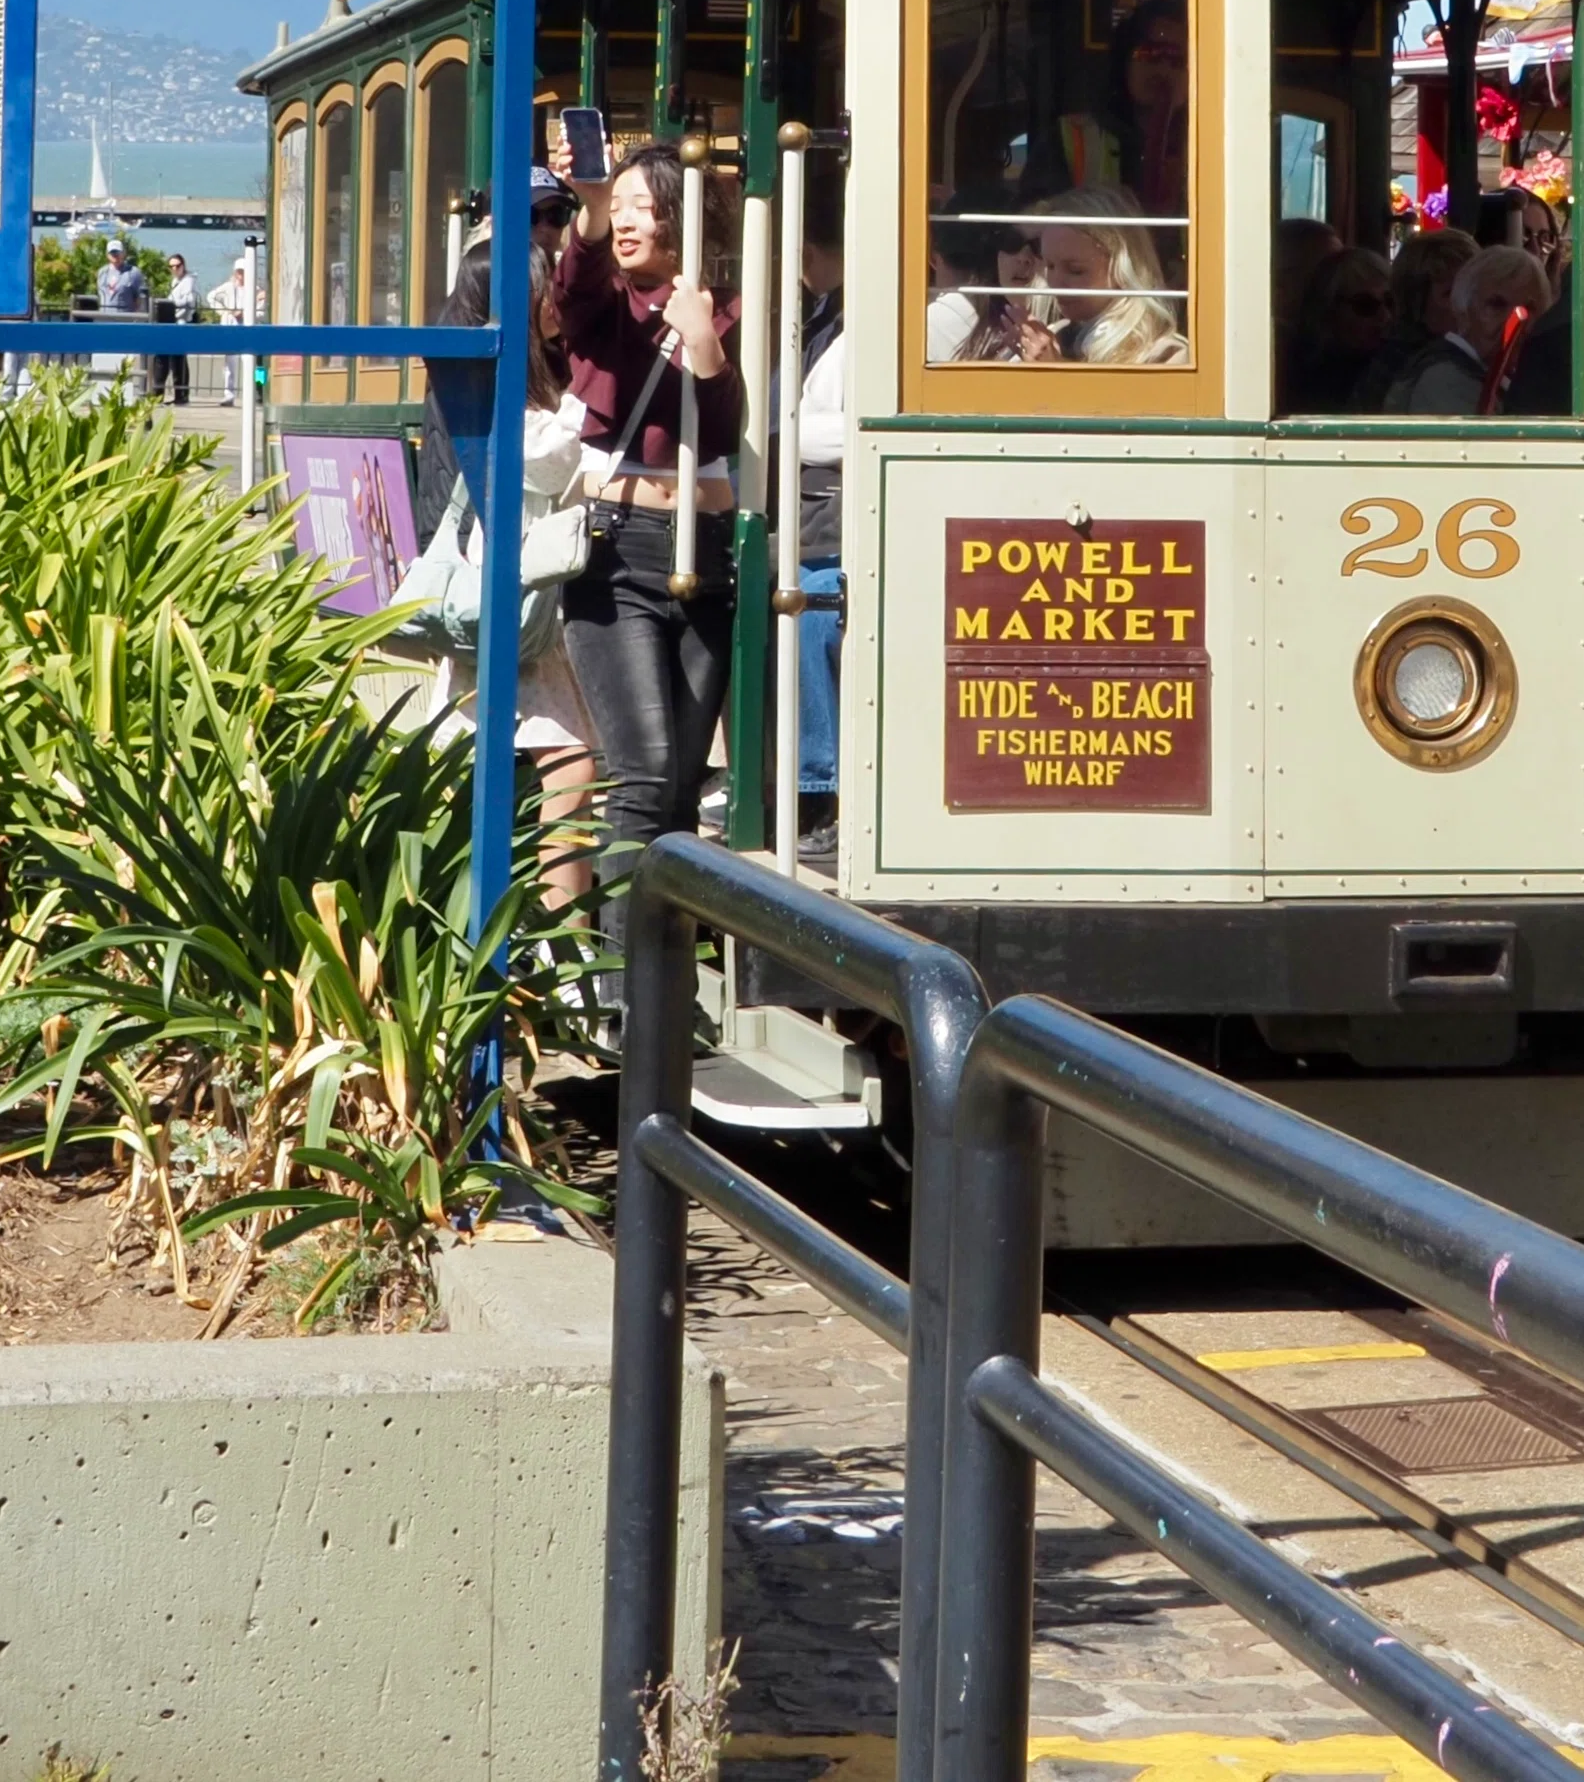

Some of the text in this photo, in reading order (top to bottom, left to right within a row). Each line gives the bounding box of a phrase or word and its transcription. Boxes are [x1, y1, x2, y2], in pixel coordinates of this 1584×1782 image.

[1340, 497, 1521, 579] 26
[961, 540, 1193, 575] POWELL
[1020, 578, 1135, 603] AND
[955, 607, 1196, 641] MARKET
[958, 680, 1193, 720] HYDE AND BEACH
[977, 729, 1173, 757] FISHERMANS
[1024, 759, 1125, 787] WHARF
